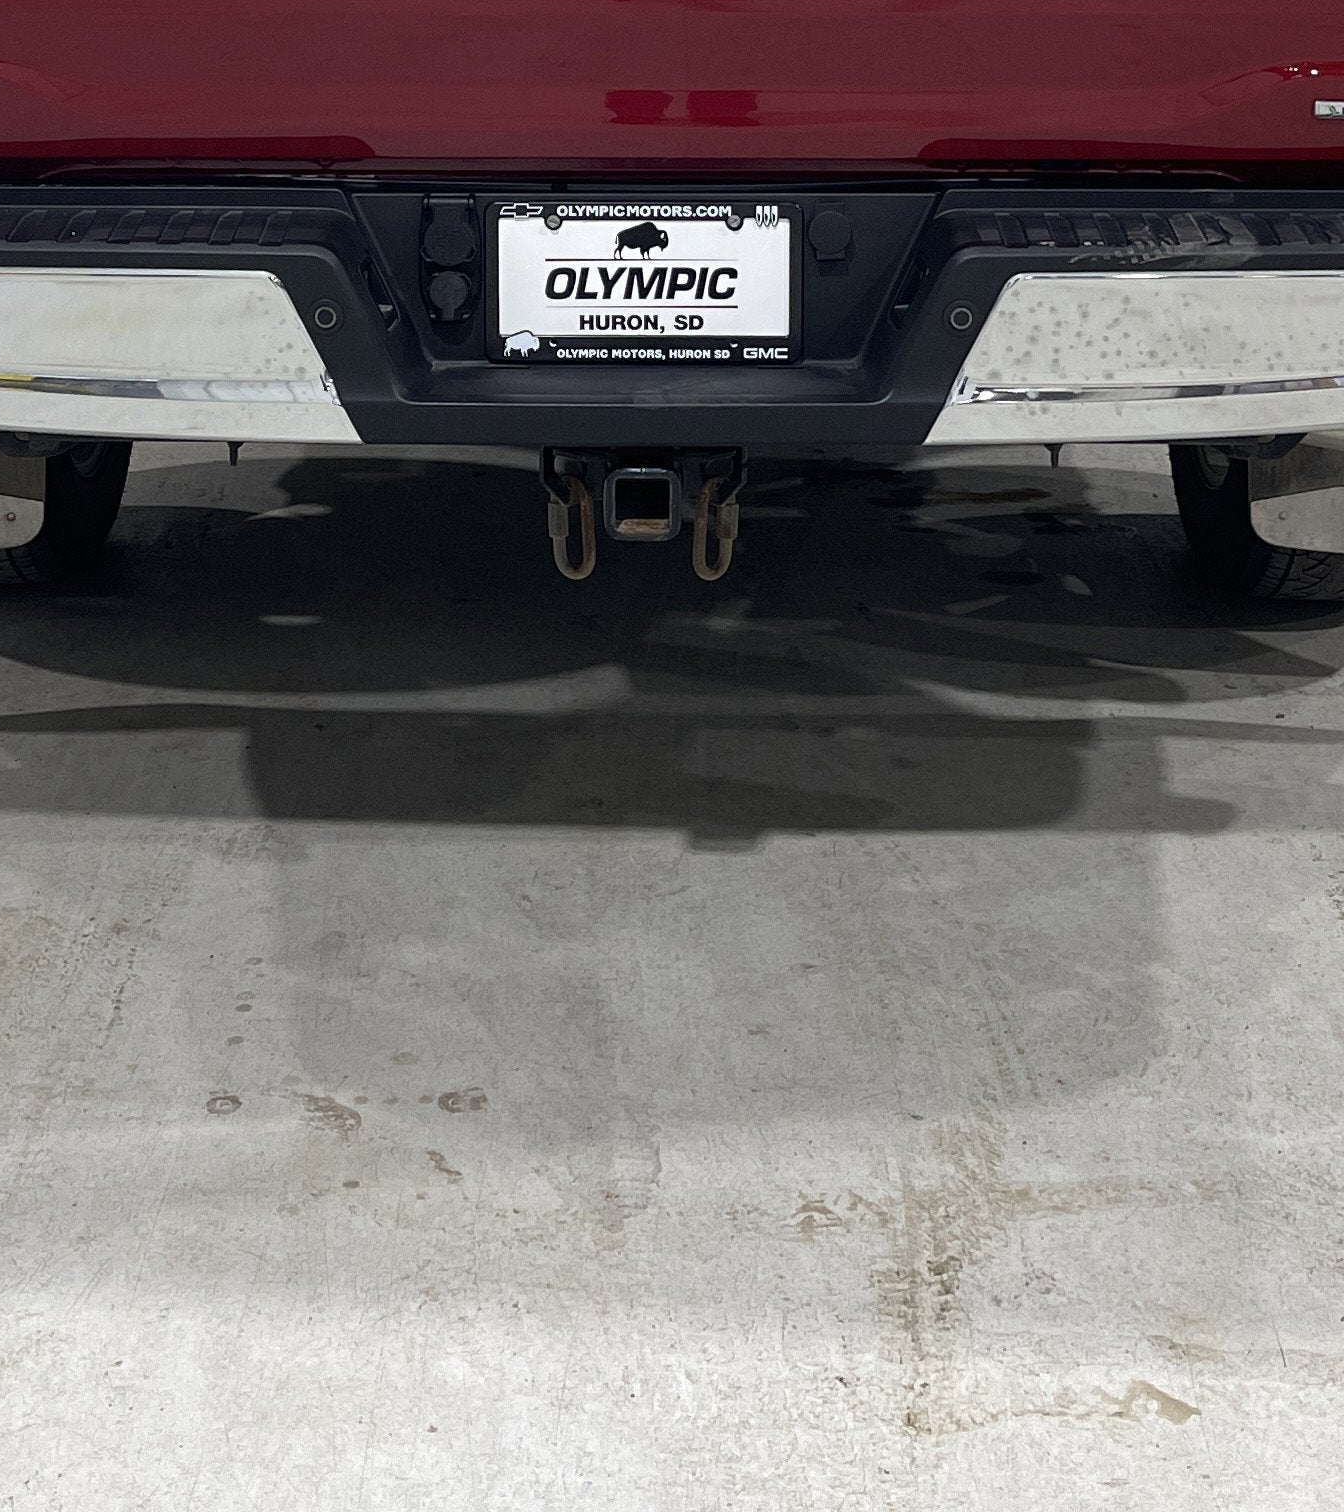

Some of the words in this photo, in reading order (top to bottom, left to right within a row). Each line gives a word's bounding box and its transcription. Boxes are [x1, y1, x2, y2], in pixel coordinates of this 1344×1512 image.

[556, 204, 732, 218] OLYMPICMOTORS.COM
[545, 266, 738, 300] OLYMPIC
[579, 314, 665, 333] HURON,
[673, 314, 704, 331] SD
[556, 349, 608, 359] OLYMPIC
[611, 349, 666, 361] MOTORS,
[669, 349, 711, 359] HURON
[713, 349, 730, 359] SD
[743, 347, 788, 359] GMC
